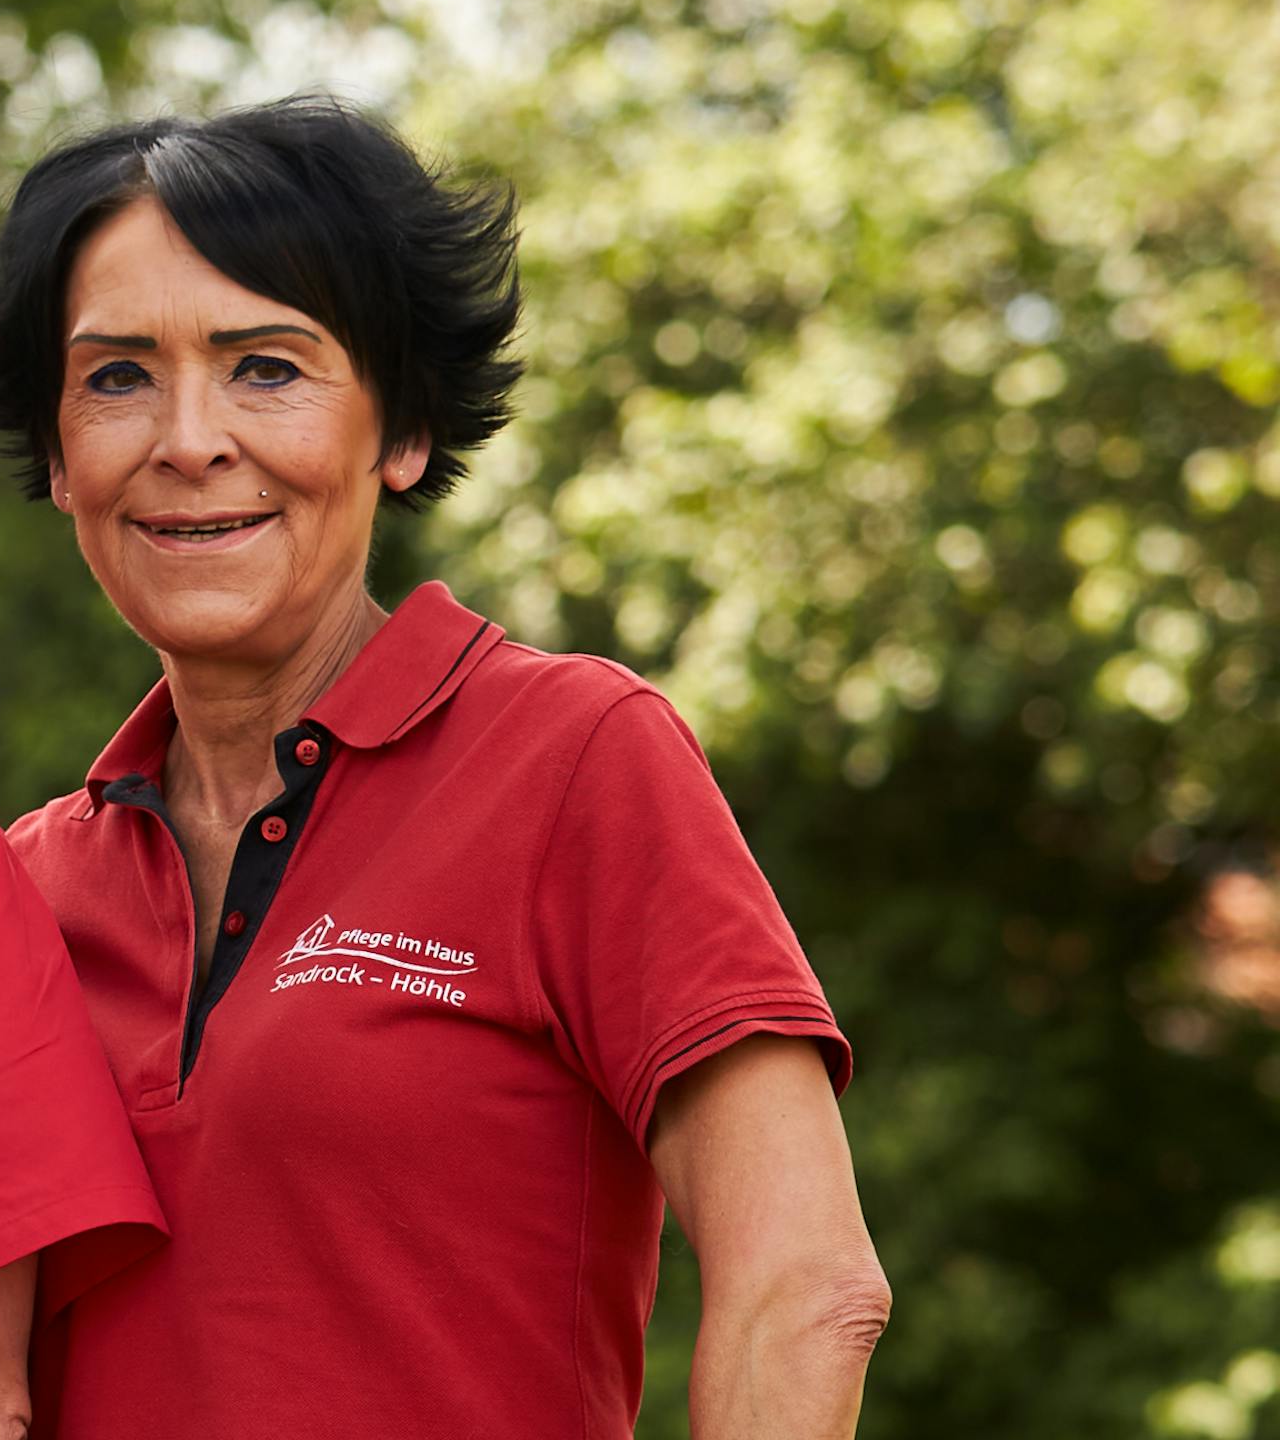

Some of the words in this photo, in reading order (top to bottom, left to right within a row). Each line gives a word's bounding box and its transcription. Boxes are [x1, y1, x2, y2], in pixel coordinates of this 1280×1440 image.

[336, 929, 393, 948] Pflege
[395, 931, 422, 954] im
[424, 939, 475, 966] Haus
[269, 963, 366, 993] Sandrock
[390, 971, 467, 1008] Höhle
